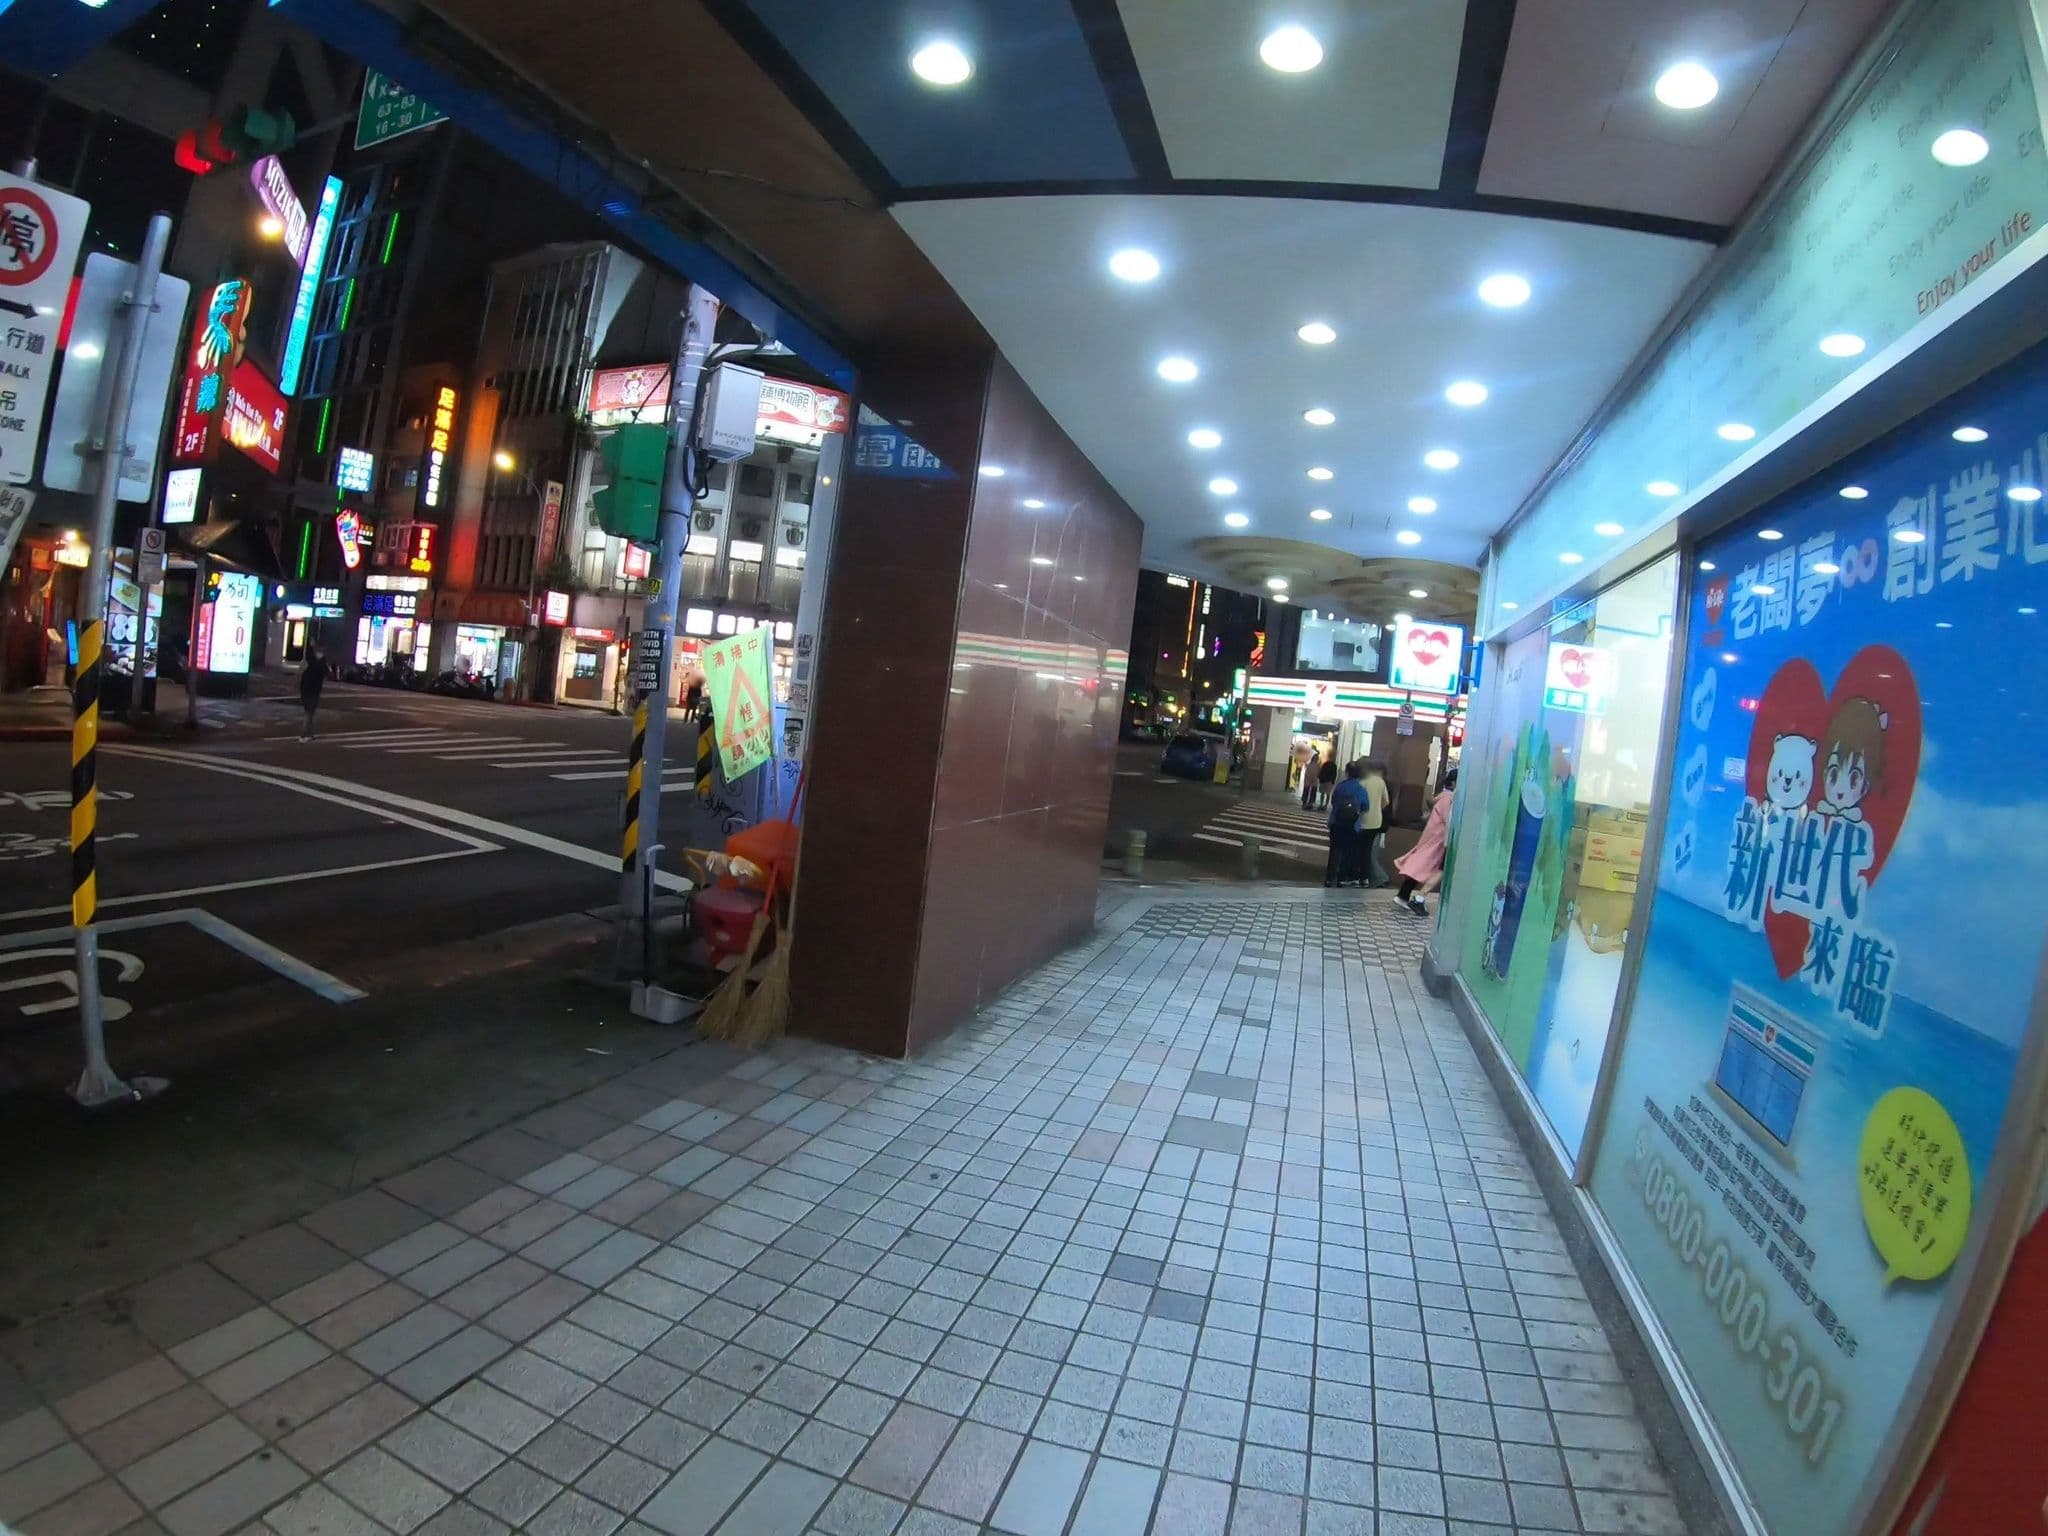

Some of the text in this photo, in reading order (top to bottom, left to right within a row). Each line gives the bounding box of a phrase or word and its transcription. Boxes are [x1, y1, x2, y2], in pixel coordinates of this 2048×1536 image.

[1917, 209, 2032, 315] Enjoy your life
[6, 327, 45, 355] 行道
[184, 432, 199, 452] 2F
[273, 408, 284, 431] 2F
[1730, 531, 1838, 640] 老闆夢
[1723, 801, 1867, 921] 新世代
[1802, 916, 1895, 1031] 來臨
[1644, 1153, 1842, 1463] 0800-000-301
